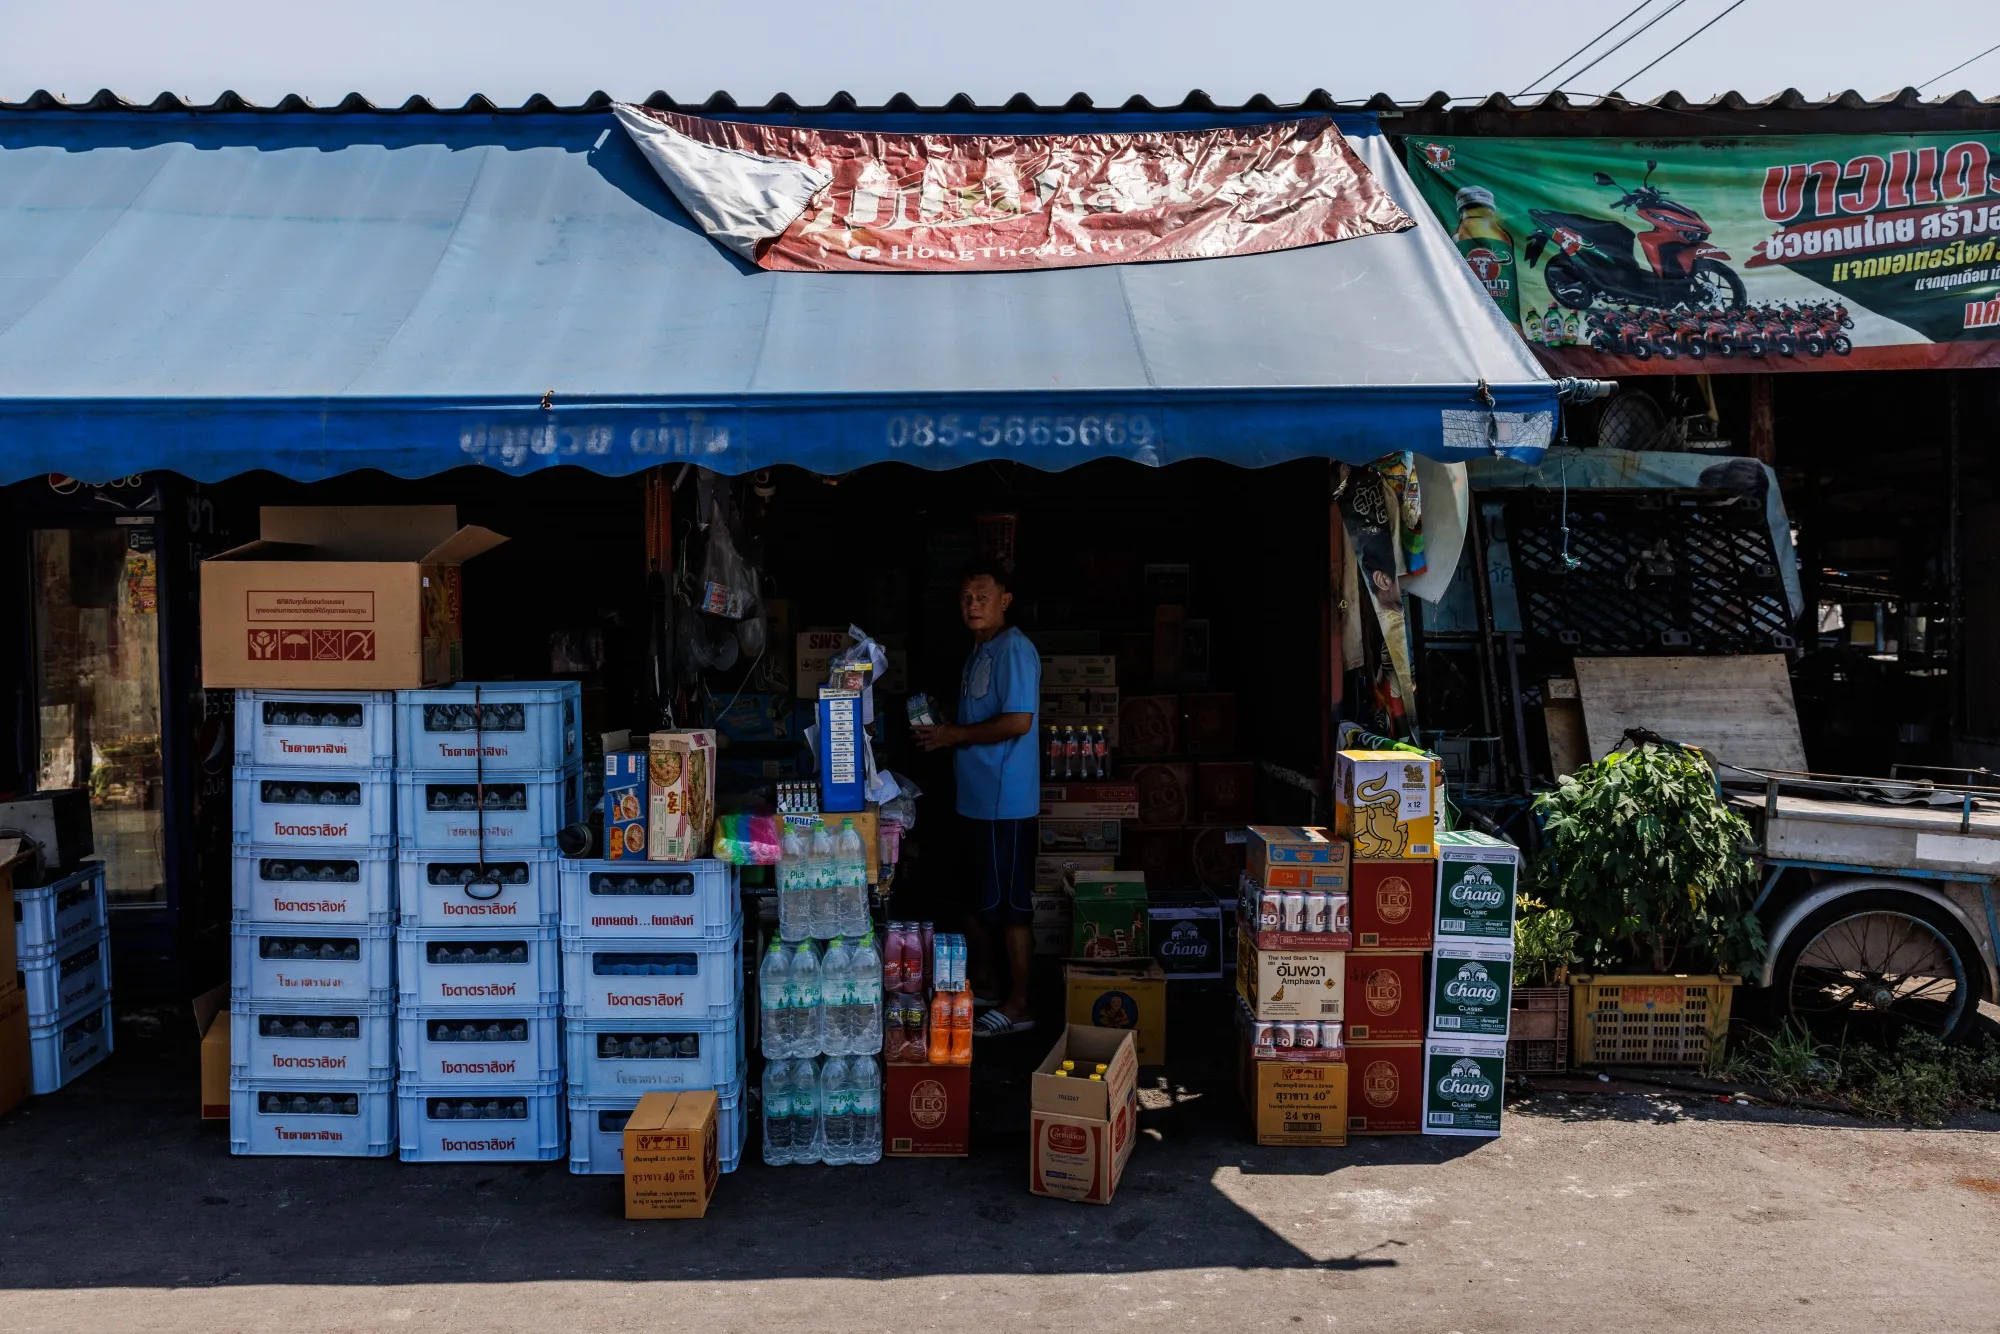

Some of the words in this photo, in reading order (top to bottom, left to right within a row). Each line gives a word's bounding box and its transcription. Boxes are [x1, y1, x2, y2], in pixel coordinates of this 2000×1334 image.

[1761, 141, 2000, 222] บาวแด
[1765, 214, 1915, 260] ช่วยคนไทย
[887, 412, 1157, 447] 085-5665669
[274, 822, 348, 837] โซดาตราสิงห์
[790, 870, 806, 879] Plus
[821, 868, 836, 878] Plus
[1379, 893, 1410, 908] LEO
[1452, 885, 1501, 905] Chang
[273, 898, 346, 913] โซดาตราสิงห์
[443, 901, 517, 915] โซดาตราสิงห์
[1161, 941, 1208, 958] Chang
[1276, 962, 1326, 977] อัมพวา
[1281, 977, 1321, 986] Amphawa
[441, 983, 516, 997] โซดาตราสิงห์
[1367, 986, 1398, 1000] LEO
[1446, 982, 1497, 1002] Chang
[607, 992, 684, 1006] โซดาตราสิงห์
[272, 1055, 347, 1069] โซดาตราสิงห์
[441, 1060, 515, 1074] โซดาตราสิงห์
[1366, 1077, 1396, 1091] LEO
[1439, 1078, 1490, 1098] Chang
[912, 1097, 943, 1111] LEO
[1275, 1091, 1309, 1104] สุราขาว
[1285, 1111, 1299, 1120] 24
[1302, 1112, 1321, 1120] ขวด
[1050, 1127, 1086, 1141] Carnation
[441, 1138, 516, 1151] โซดาตราสิงห์
[632, 1172, 662, 1185] สุราขาว
[663, 1172, 676, 1183] 40
[678, 1169, 695, 1181] ดีกรี
